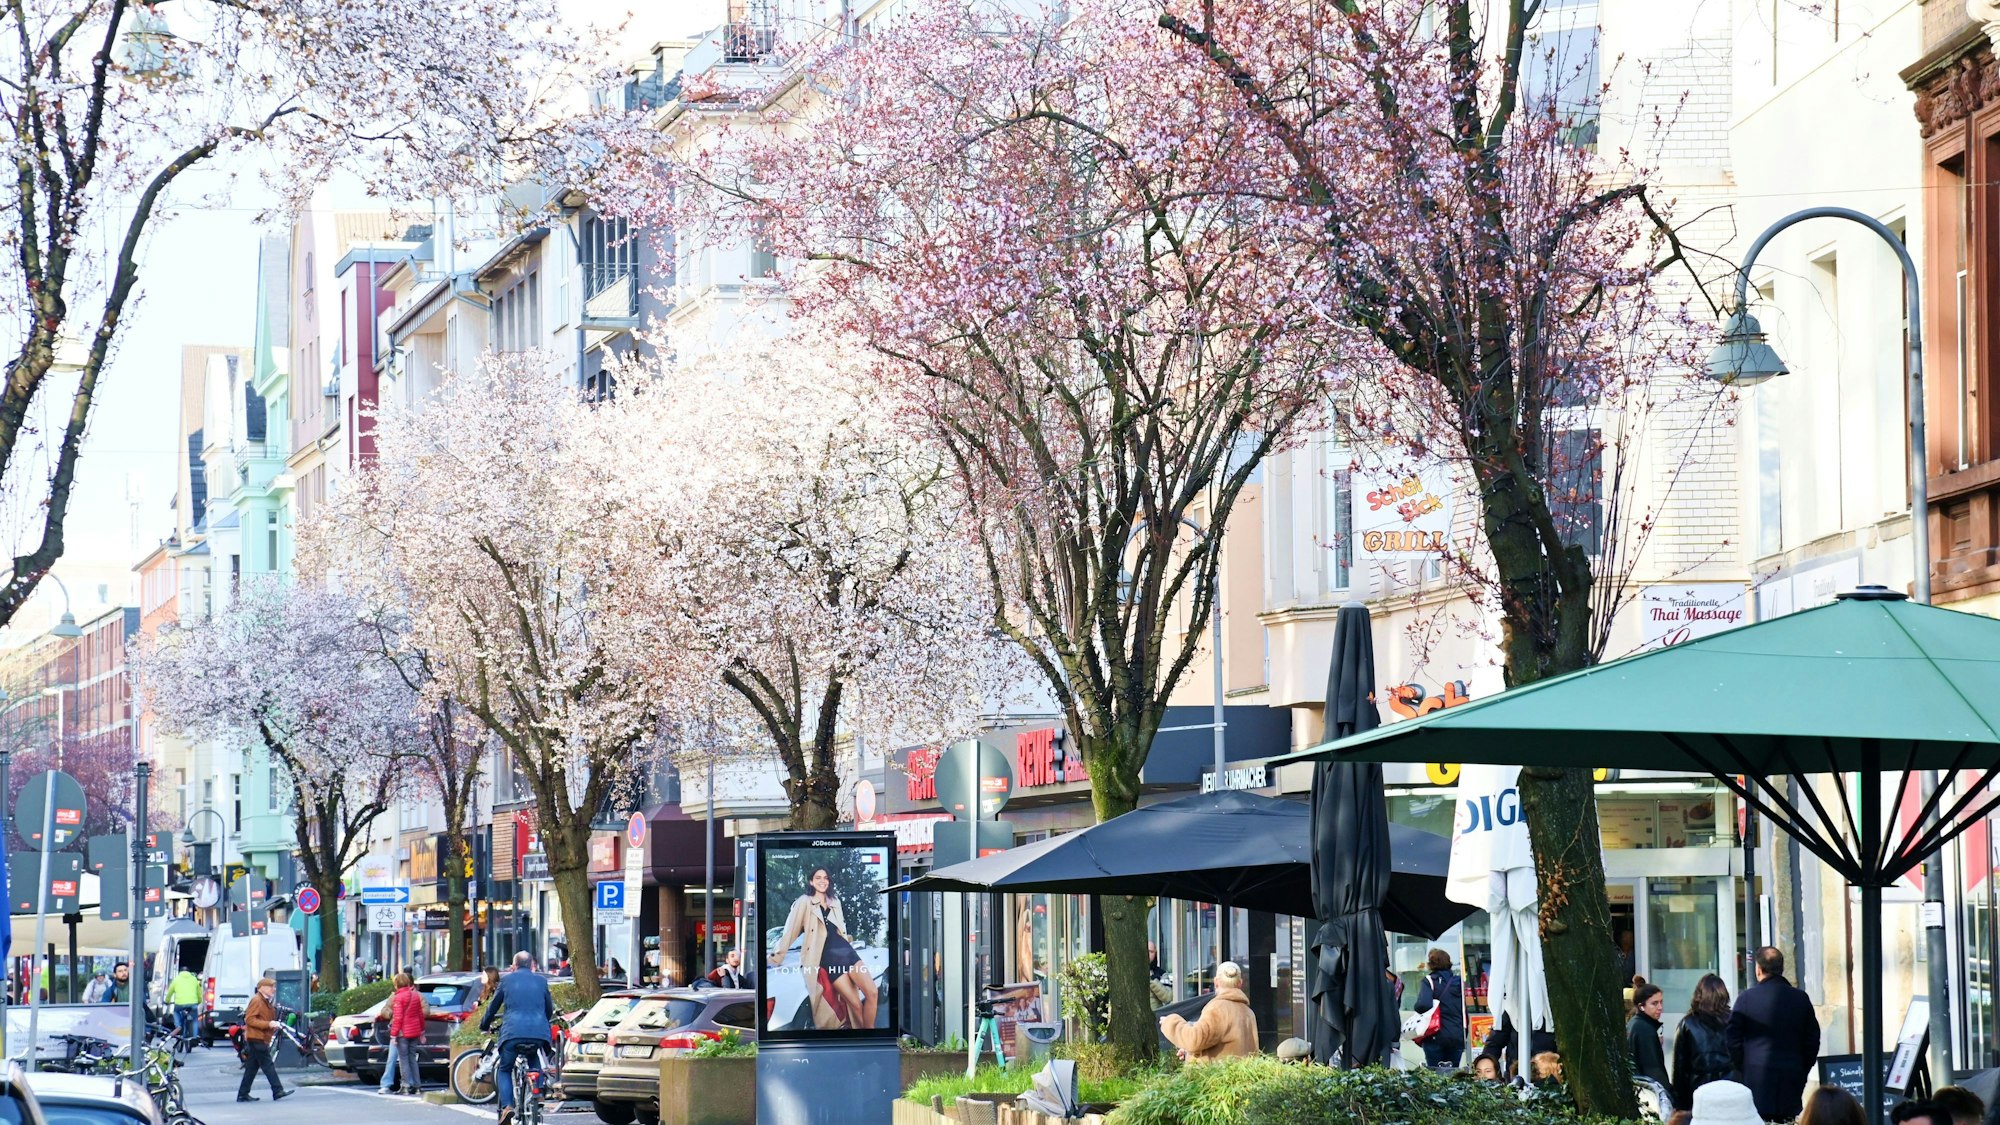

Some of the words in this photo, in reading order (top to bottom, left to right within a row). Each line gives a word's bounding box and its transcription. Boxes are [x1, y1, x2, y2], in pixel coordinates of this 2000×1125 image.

[1366, 473, 1423, 511] Schäl
[1363, 531, 1448, 552] GRILL
[1671, 599, 1719, 607] Traditionelle
[1650, 608, 1680, 621] Thai
[1684, 607, 1742, 623] Massage
[1016, 728, 1057, 788] REWE
[1229, 765, 1266, 790] UHRMACHER
[603, 884, 619, 906] P
[773, 965, 821, 975] TOMMY
[828, 963, 883, 975] HILFIGER
